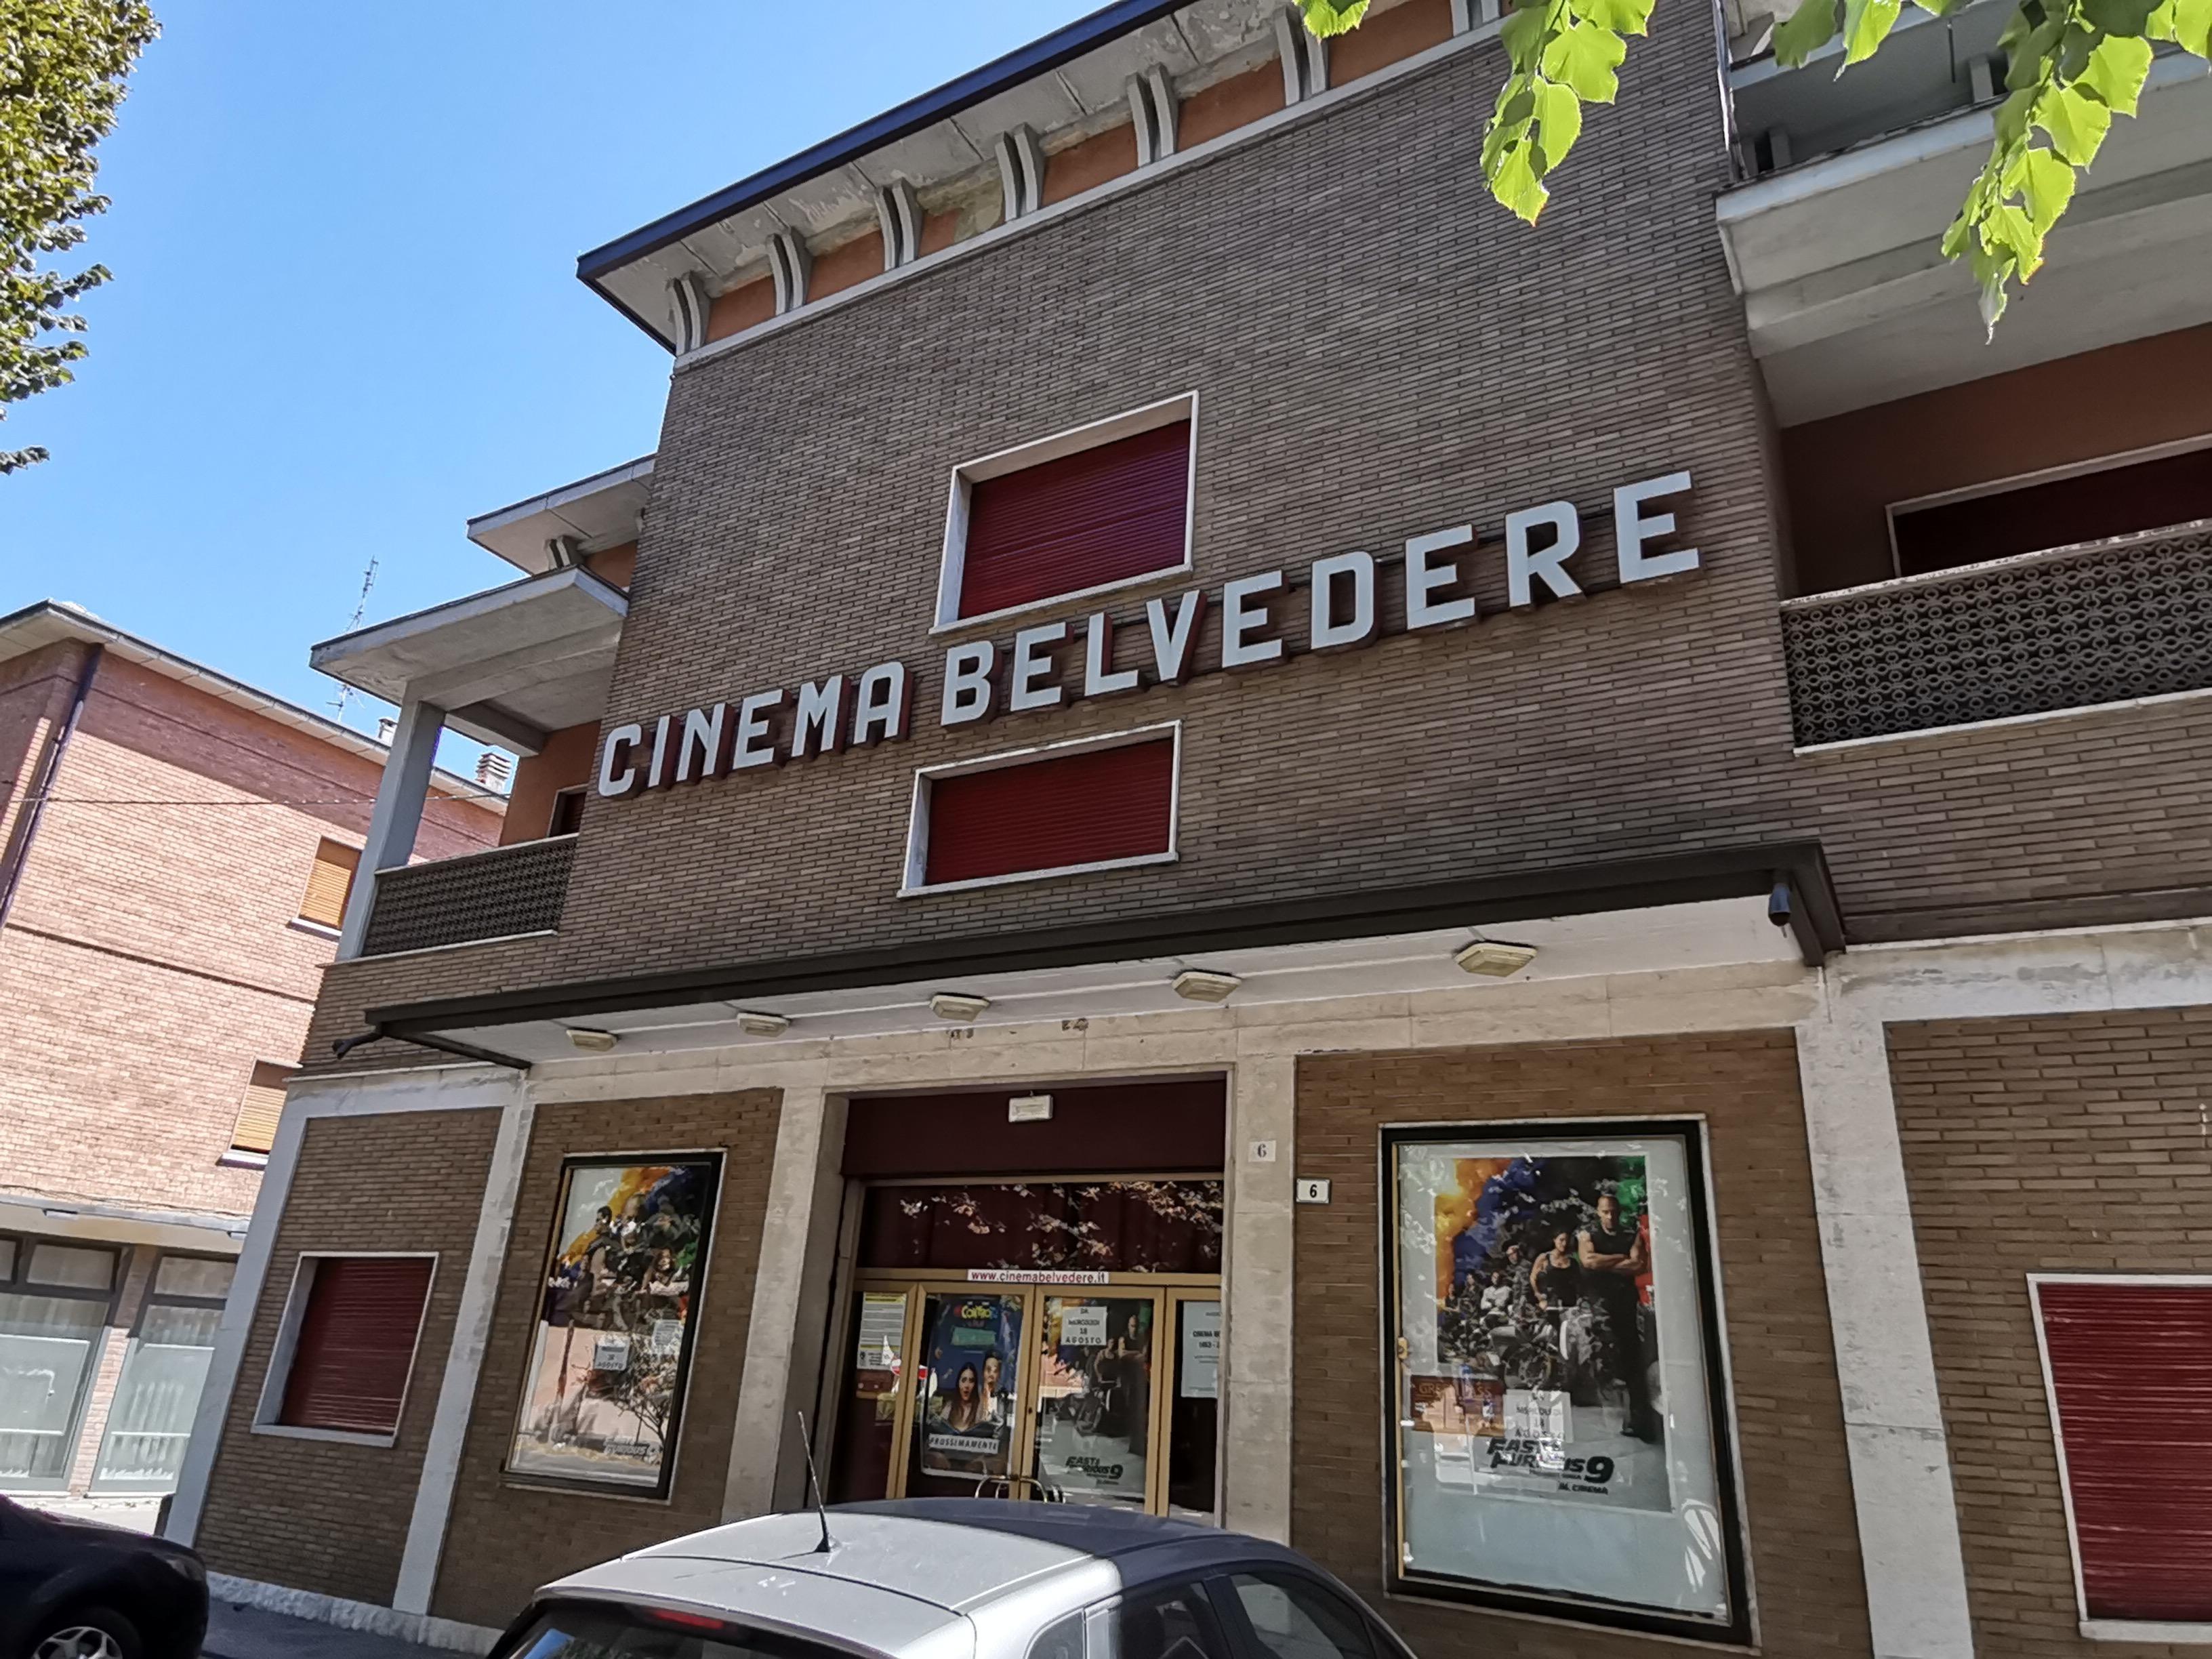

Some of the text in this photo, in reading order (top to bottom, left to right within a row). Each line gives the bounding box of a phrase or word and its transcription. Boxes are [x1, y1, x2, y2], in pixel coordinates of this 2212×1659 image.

[598, 470, 1700, 798] CINEMA BELVEDERE
[1257, 1143, 1267, 1158] 6
[1309, 1183, 1317, 1198] 6
[970, 1271, 1105, 1284] www.cinemabelvedere.it
[1065, 1336, 1102, 1344] AGOSTO
[930, 1437, 997, 1450] PROSSIMAMENTE
[1584, 1456, 1616, 1483] 9
